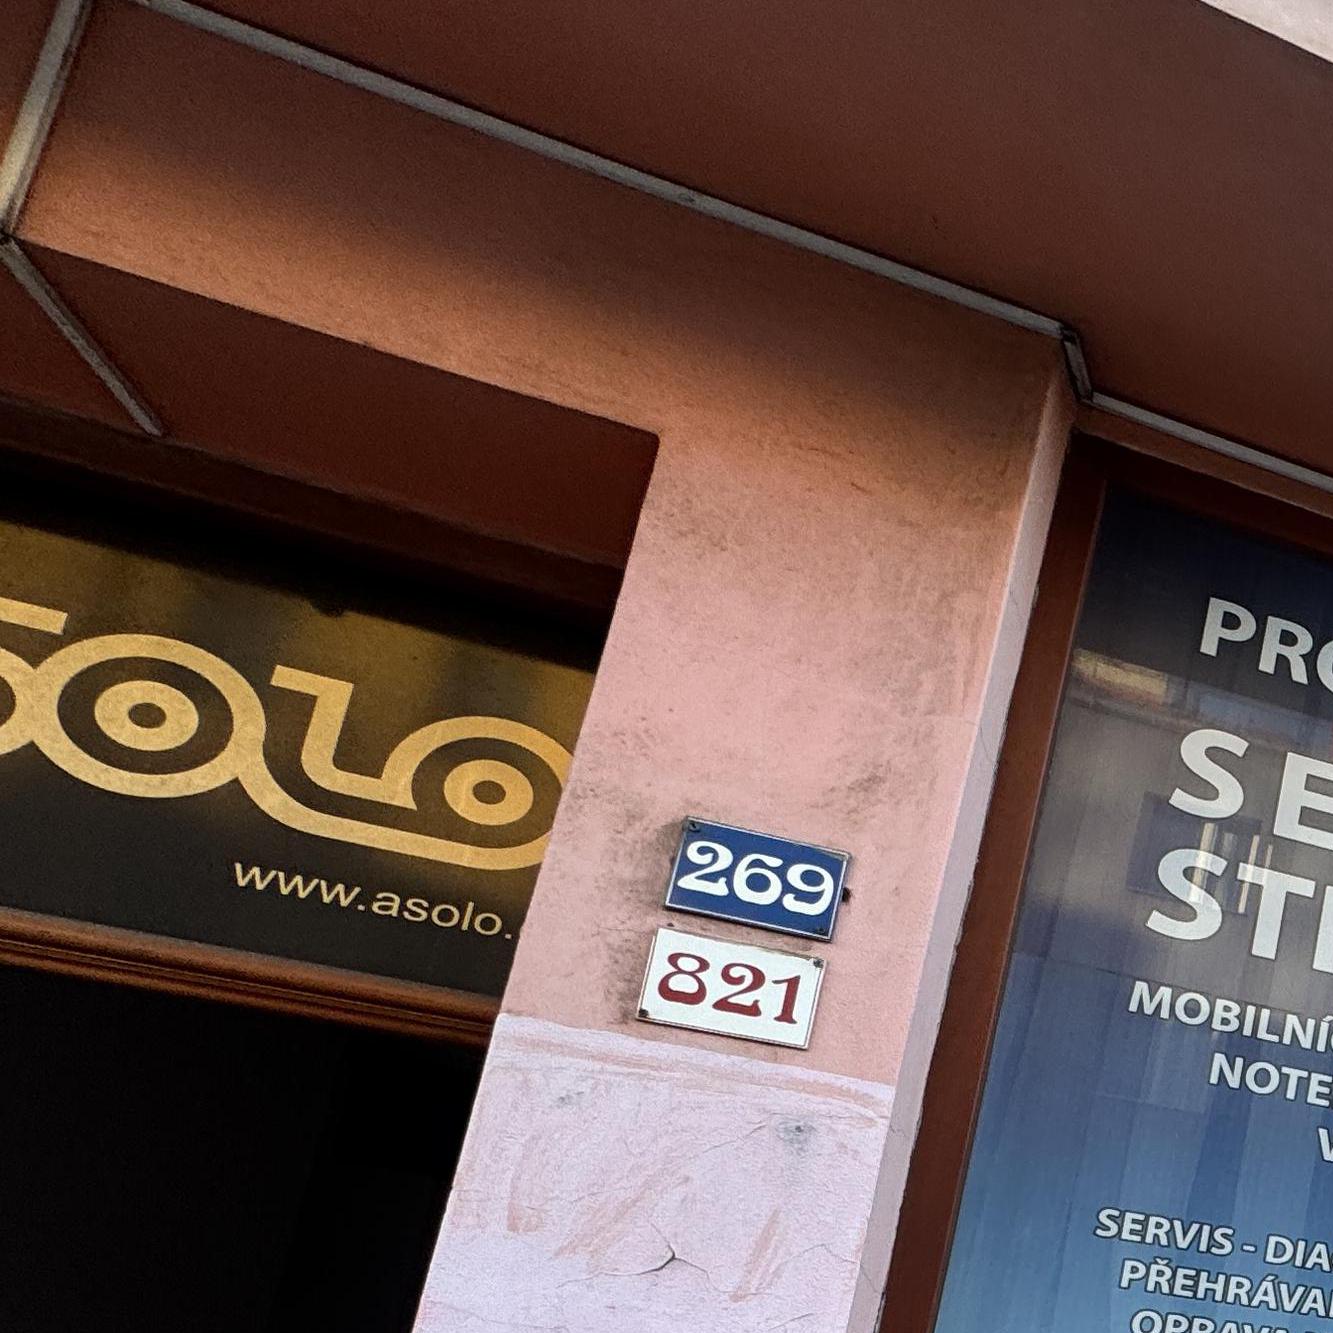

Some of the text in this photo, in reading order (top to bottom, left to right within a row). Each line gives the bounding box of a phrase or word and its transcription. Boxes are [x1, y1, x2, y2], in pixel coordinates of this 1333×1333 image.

[678, 840, 837, 918] 269
[657, 951, 800, 1025] 821
[1094, 1207, 1234, 1257] SERVIS
